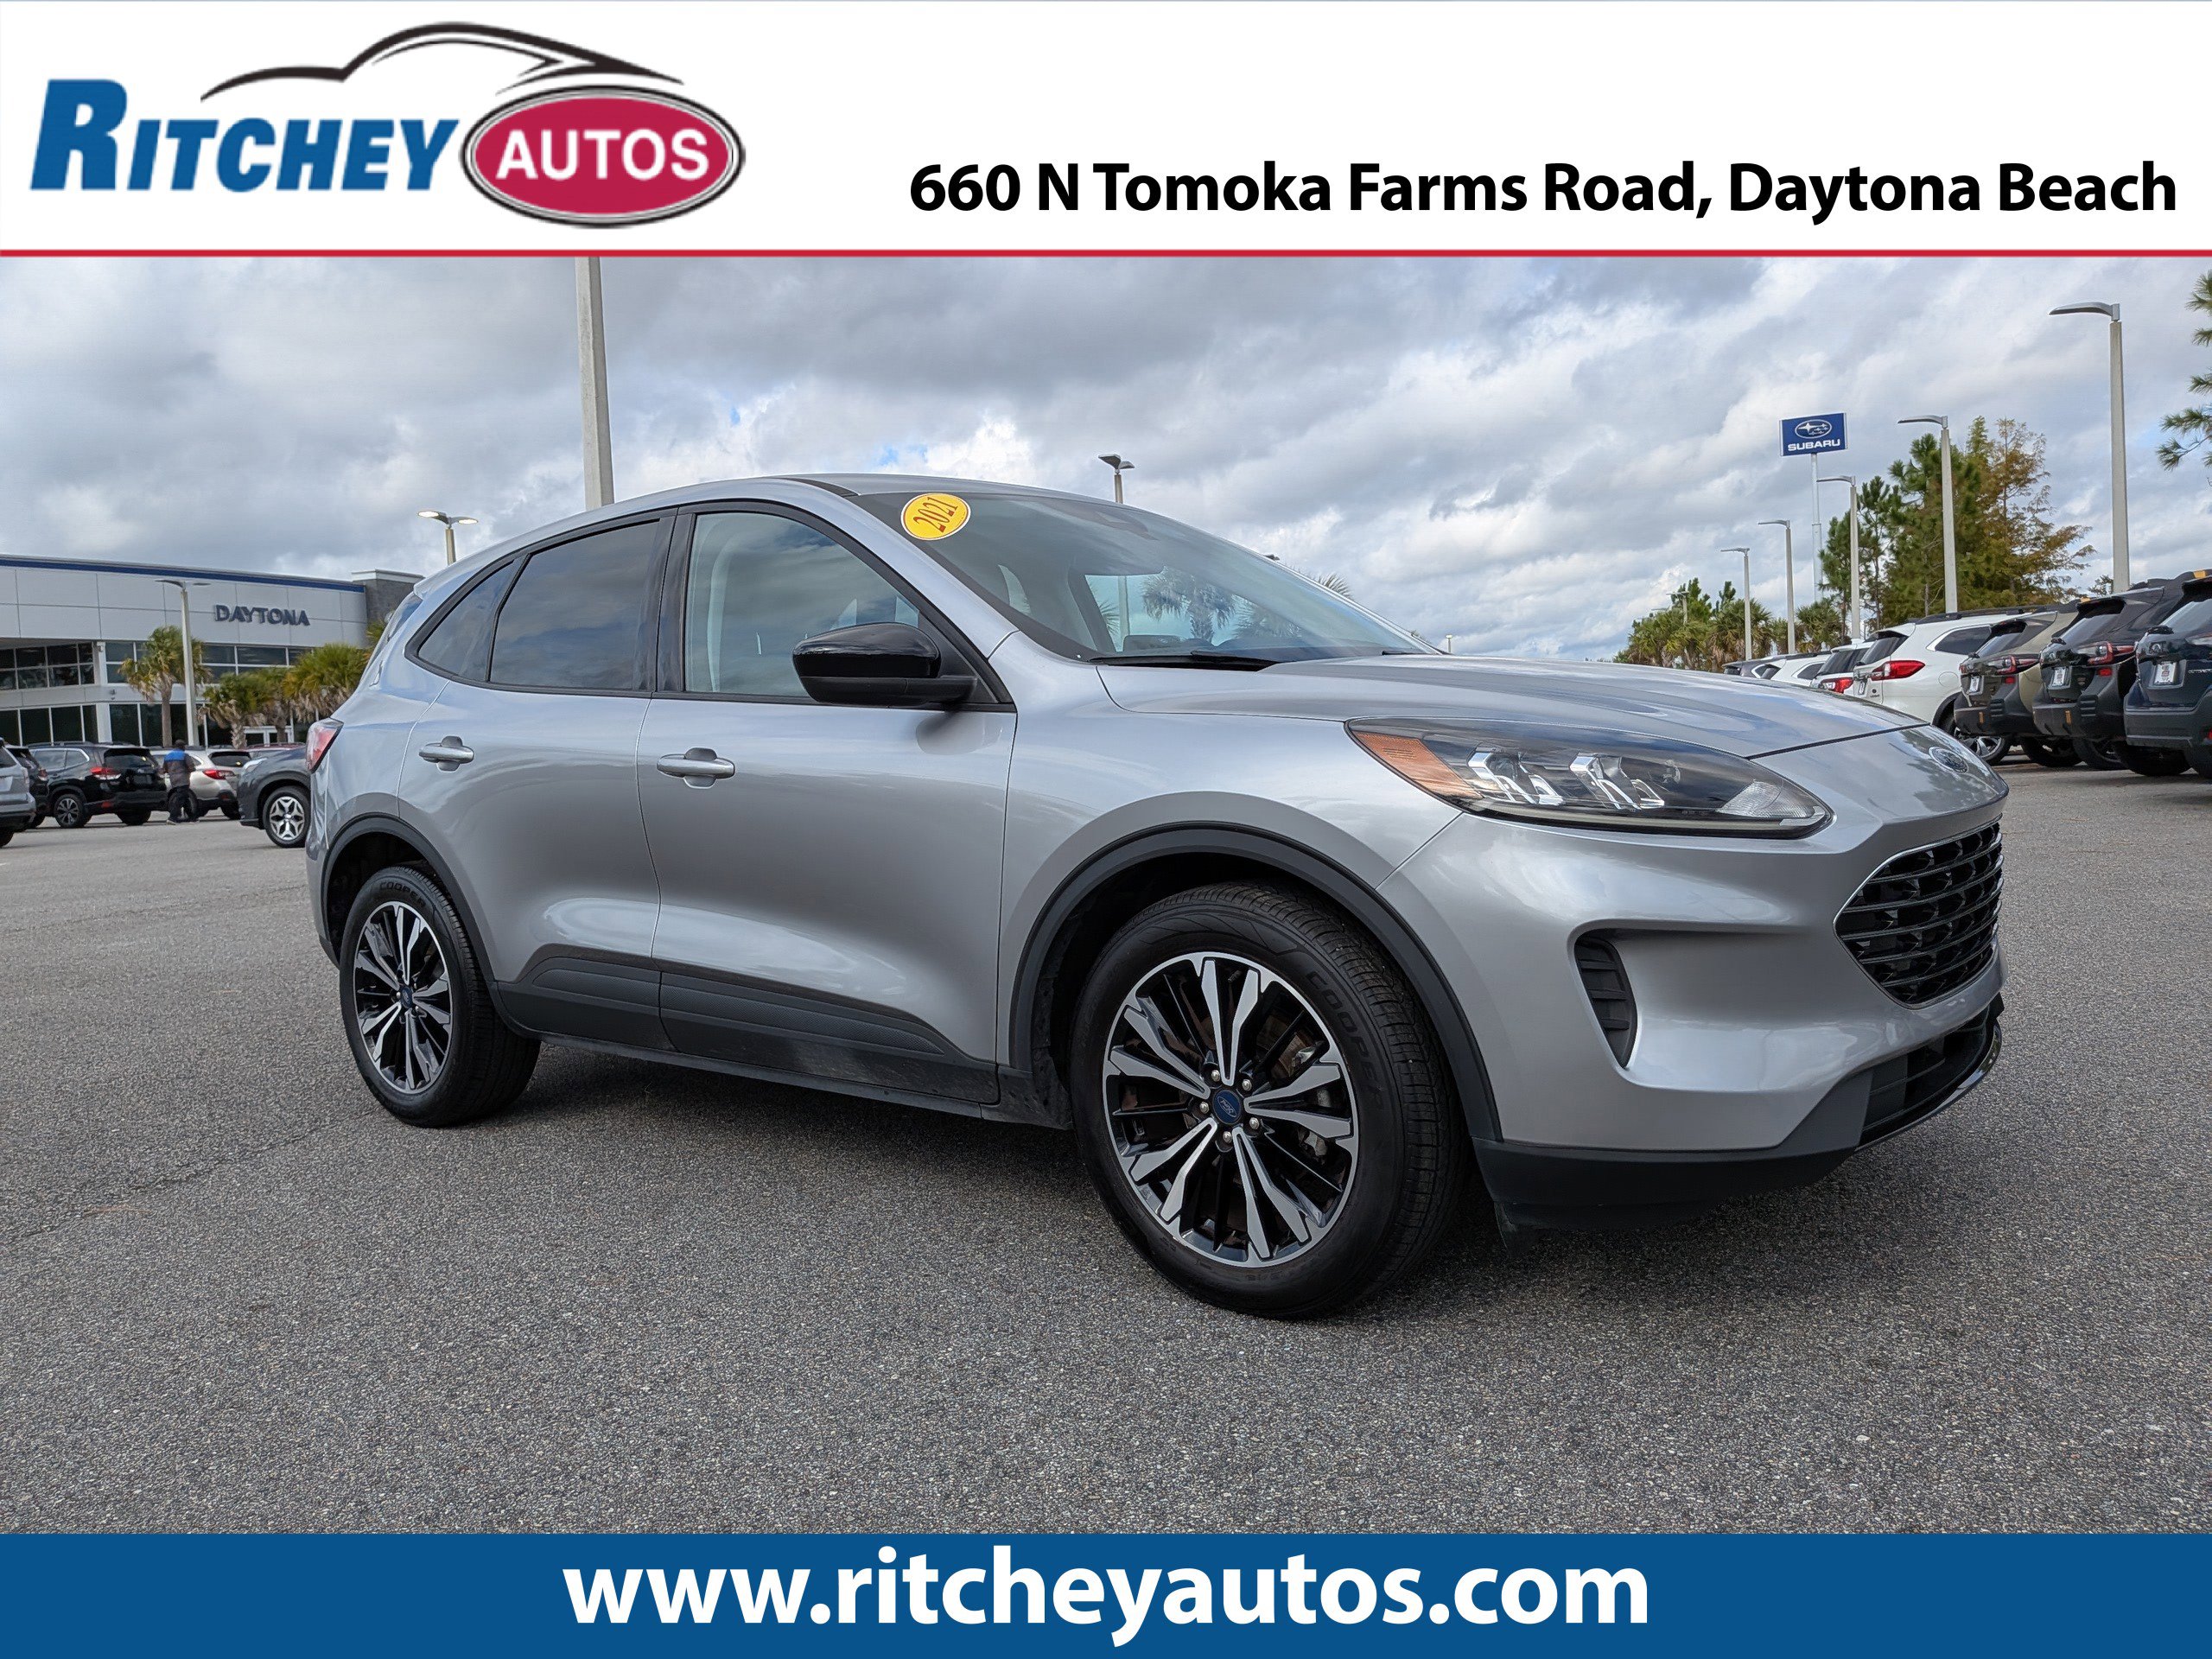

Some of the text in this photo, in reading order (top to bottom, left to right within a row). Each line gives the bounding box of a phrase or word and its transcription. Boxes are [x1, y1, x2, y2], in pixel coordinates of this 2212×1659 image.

[1788, 439, 1840, 451] SUBARU
[912, 497, 958, 533] 2021
[214, 604, 311, 626] DAYTONA
